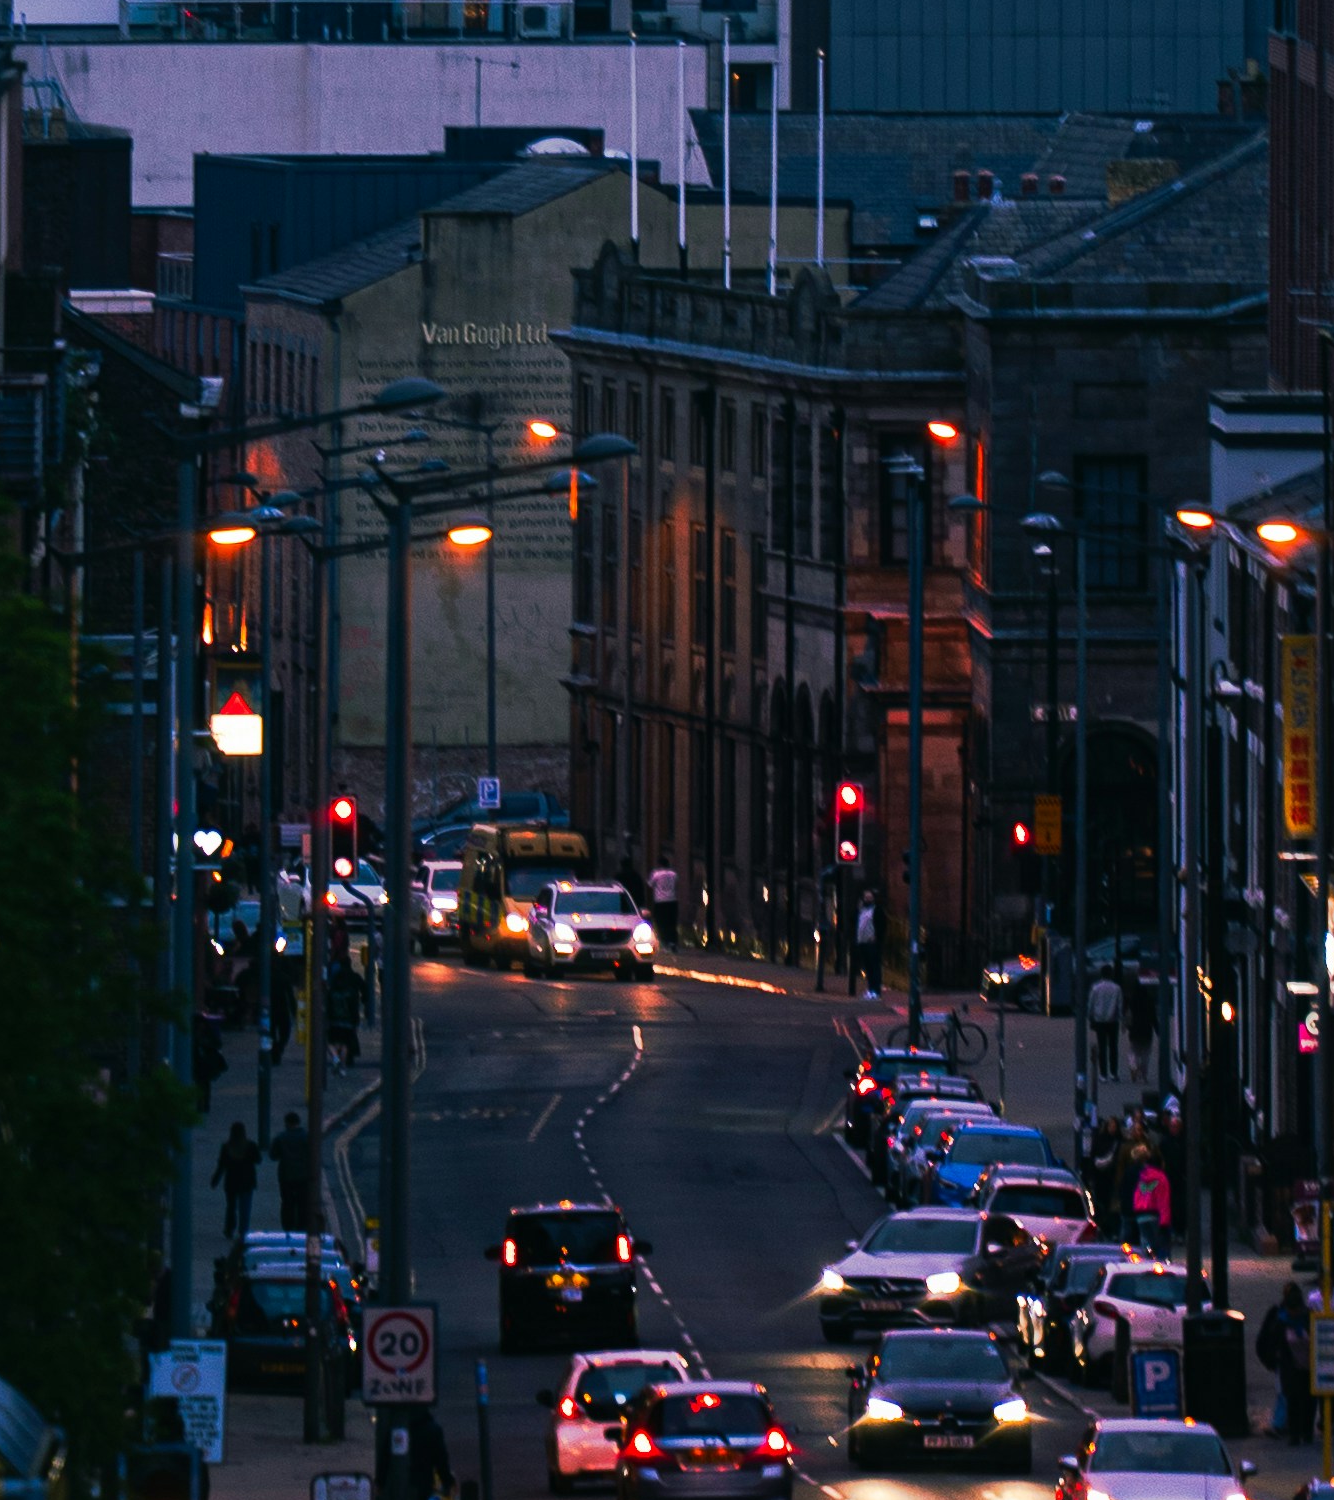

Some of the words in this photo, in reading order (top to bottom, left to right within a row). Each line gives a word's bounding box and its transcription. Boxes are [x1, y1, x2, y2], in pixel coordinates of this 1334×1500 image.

[421, 321, 460, 345] Van
[463, 321, 513, 351] Gogh
[380, 1331, 419, 1357] 20
[1144, 1360, 1171, 1393] P
